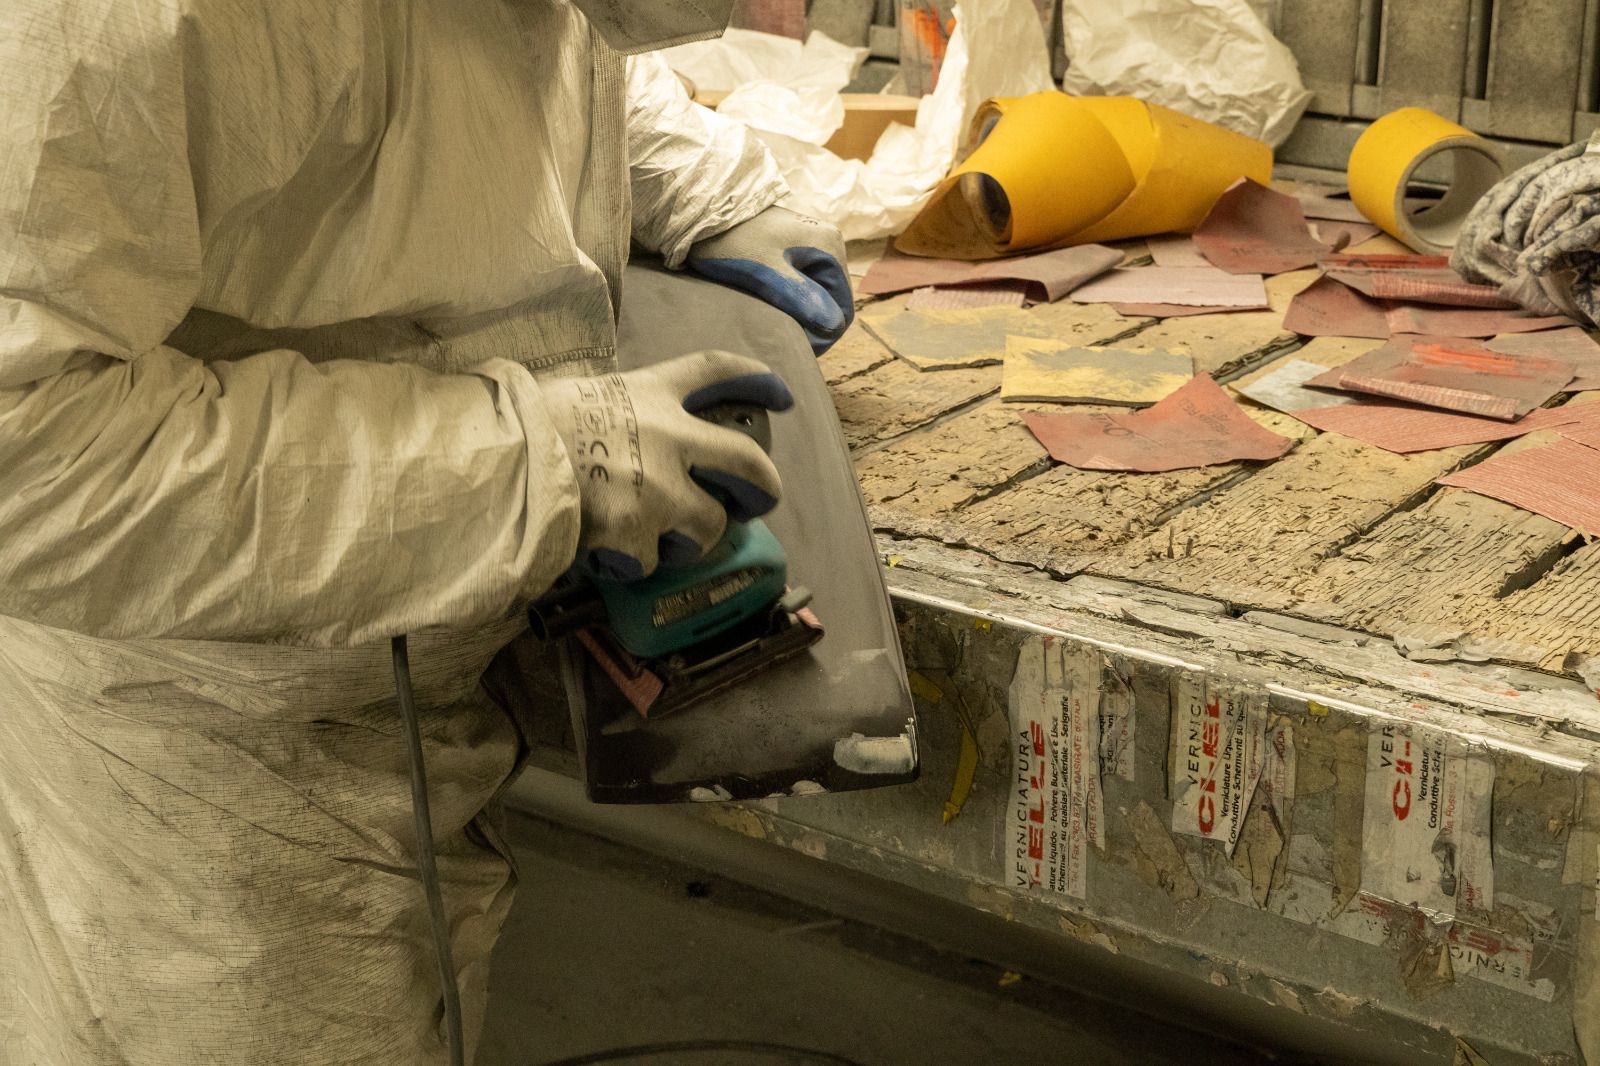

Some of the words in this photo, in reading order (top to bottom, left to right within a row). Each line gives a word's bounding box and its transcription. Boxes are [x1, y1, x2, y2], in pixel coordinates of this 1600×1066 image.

[1380, 725, 1394, 768] VER
[1050, 789, 1058, 822] Polvere
[1221, 763, 1231, 817] Verniciature
[1228, 793, 1240, 844] Conduttive
[1236, 725, 1244, 736] su
[1428, 776, 1440, 829] Conduttive
[1016, 730, 1030, 887] VERNICIATURA
[1060, 790, 1069, 828] qualsiasi
[1049, 831, 1058, 864] Liquido
[1061, 830, 1067, 841] su
